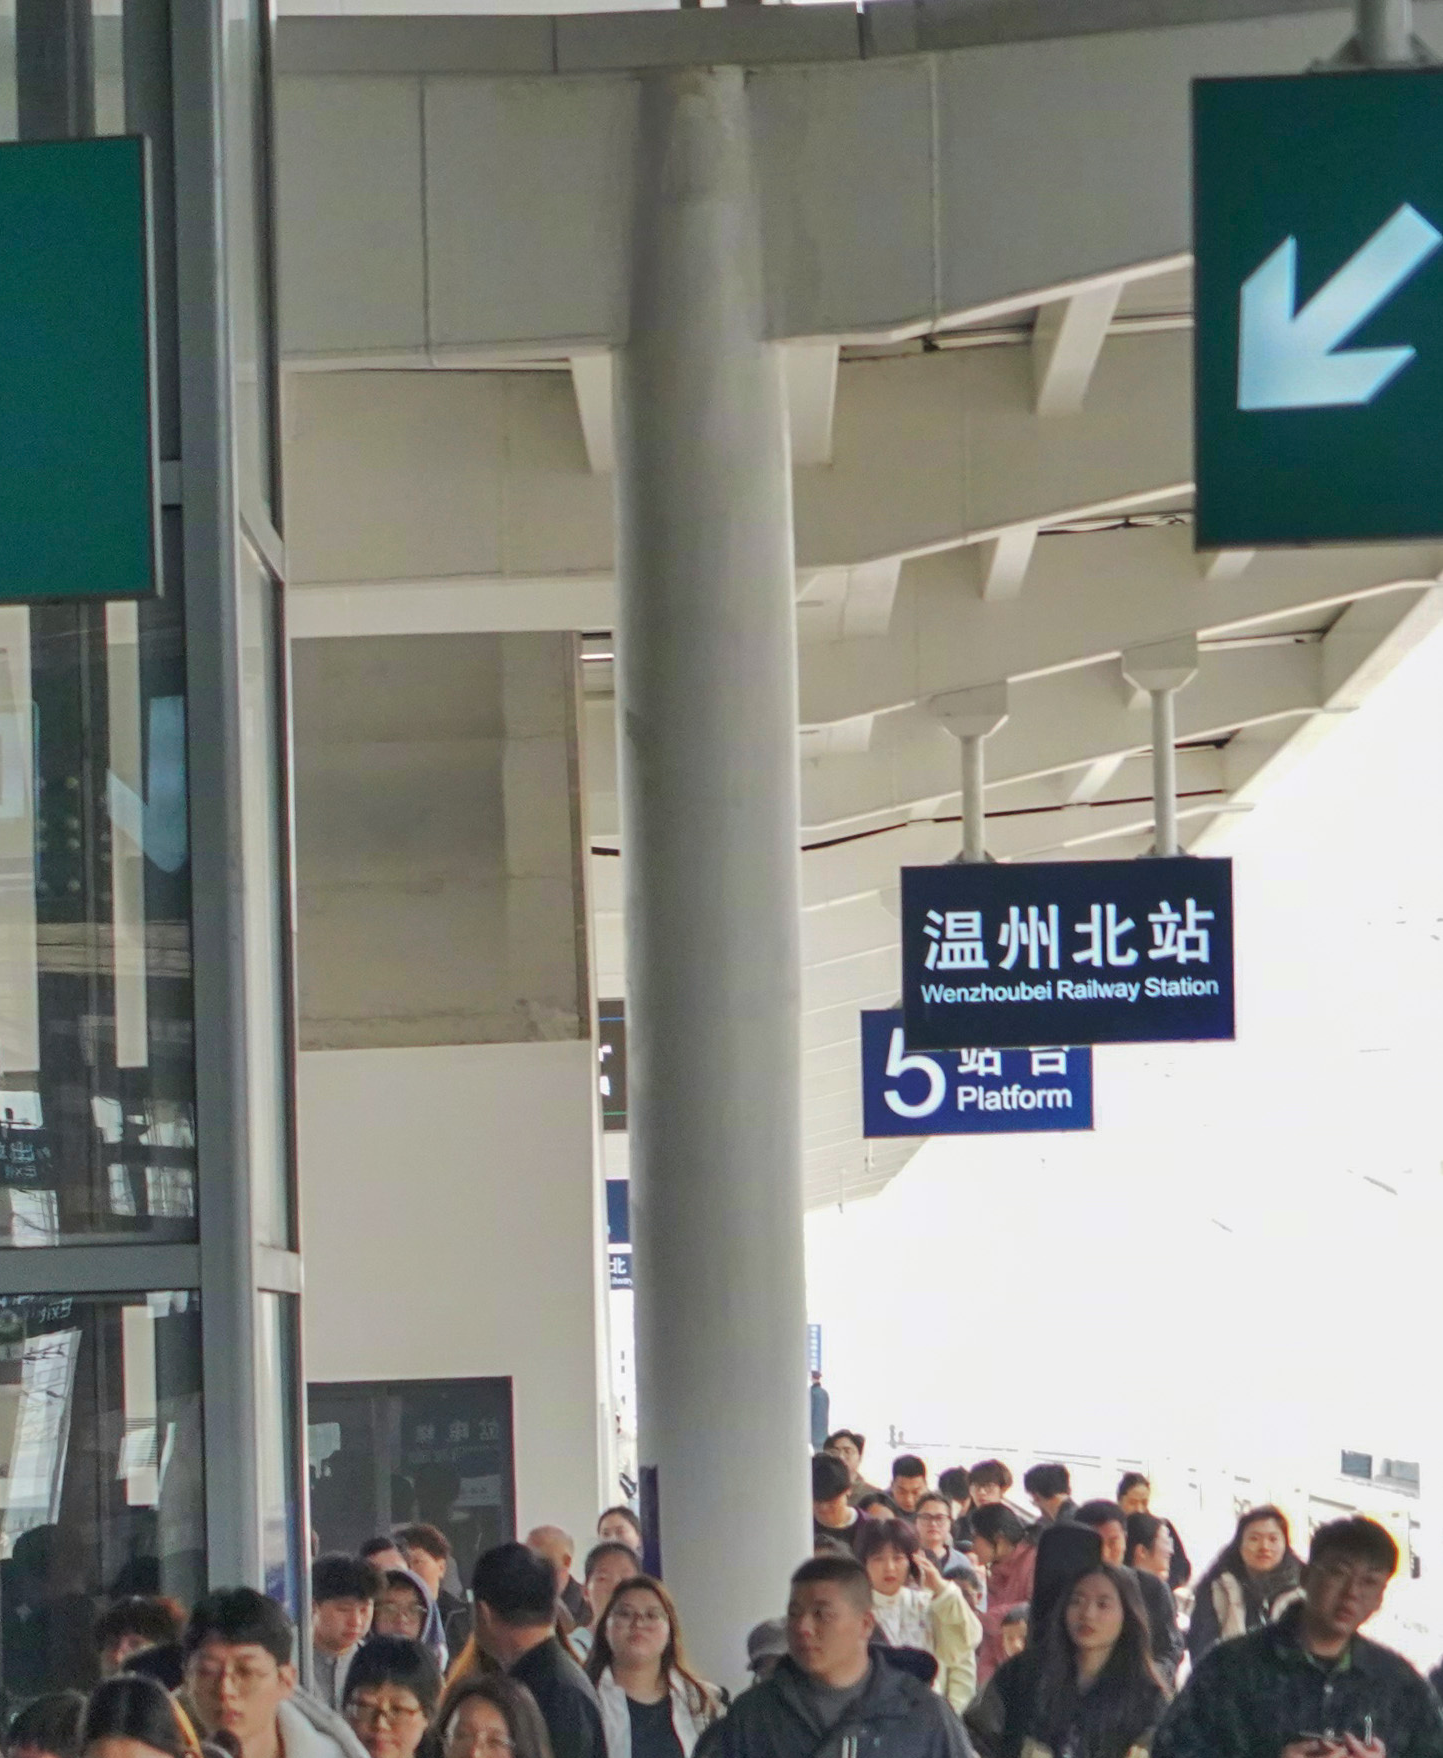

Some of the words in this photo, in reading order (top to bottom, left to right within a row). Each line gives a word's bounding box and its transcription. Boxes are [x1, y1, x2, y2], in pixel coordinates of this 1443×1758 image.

[922, 898, 1215, 971] 温州北站
[921, 979, 1053, 1004] Wenzhoubei
[1056, 978, 1141, 1003] Railway
[1144, 976, 1219, 998] Station
[883, 1027, 947, 1118] 5
[957, 1083, 1073, 1112] Platform
